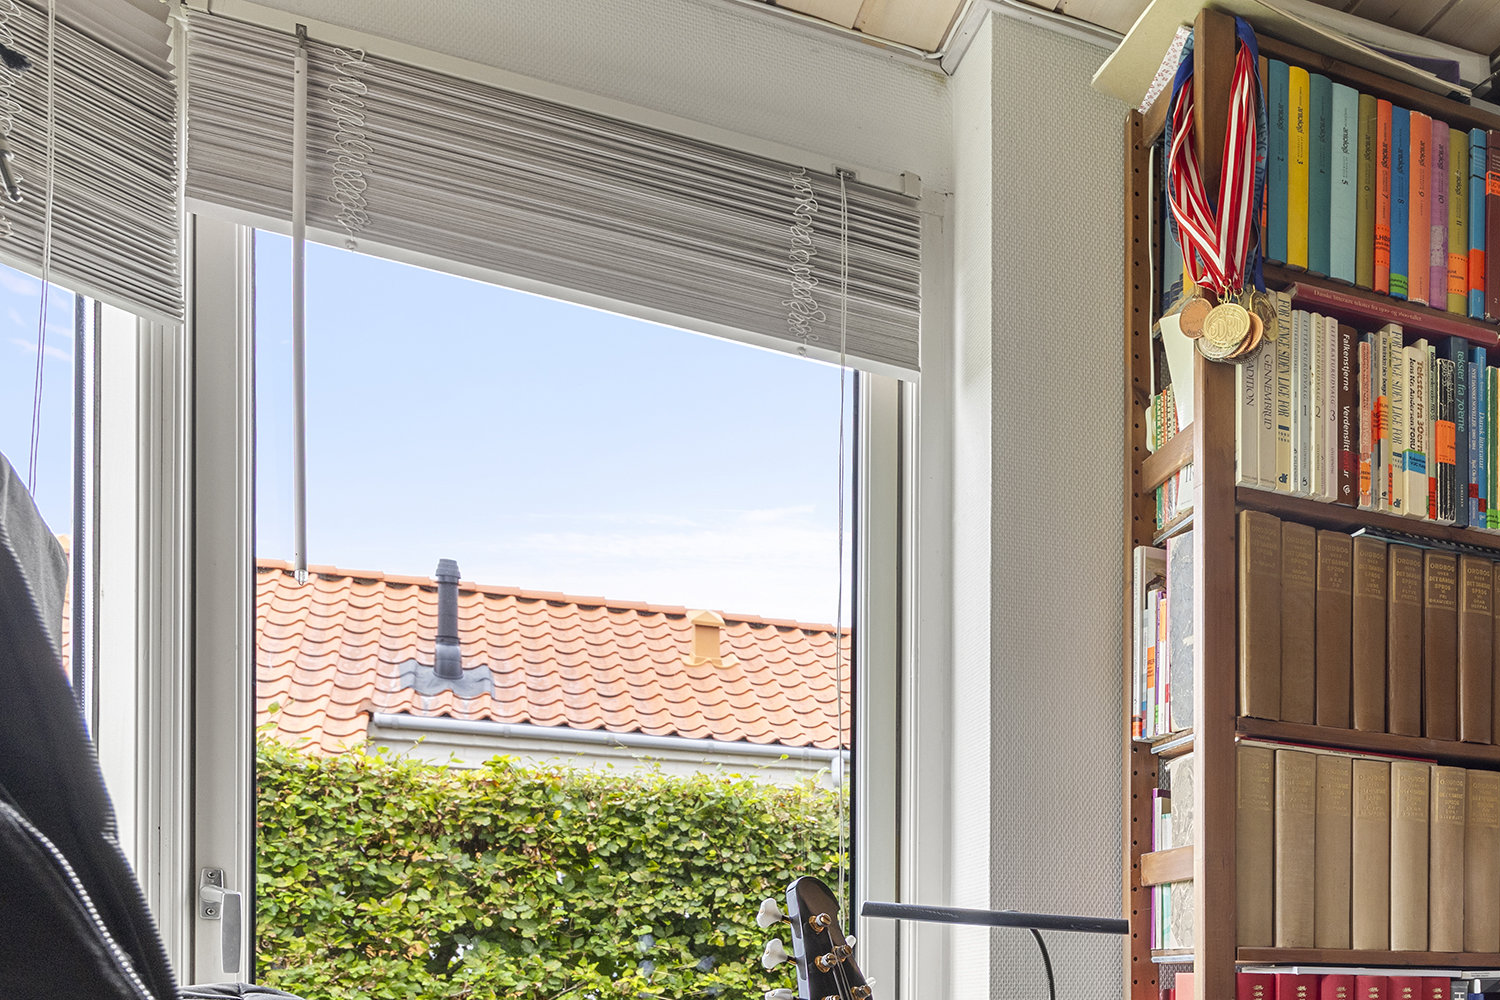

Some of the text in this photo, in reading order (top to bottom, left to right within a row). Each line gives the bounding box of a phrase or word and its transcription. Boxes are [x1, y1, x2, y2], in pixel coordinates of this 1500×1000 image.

[1277, 352, 1289, 374] SIDEN
[1458, 351, 1466, 379] tekster
[1277, 377, 1289, 396] LIGE
[1458, 384, 1466, 395] fra
